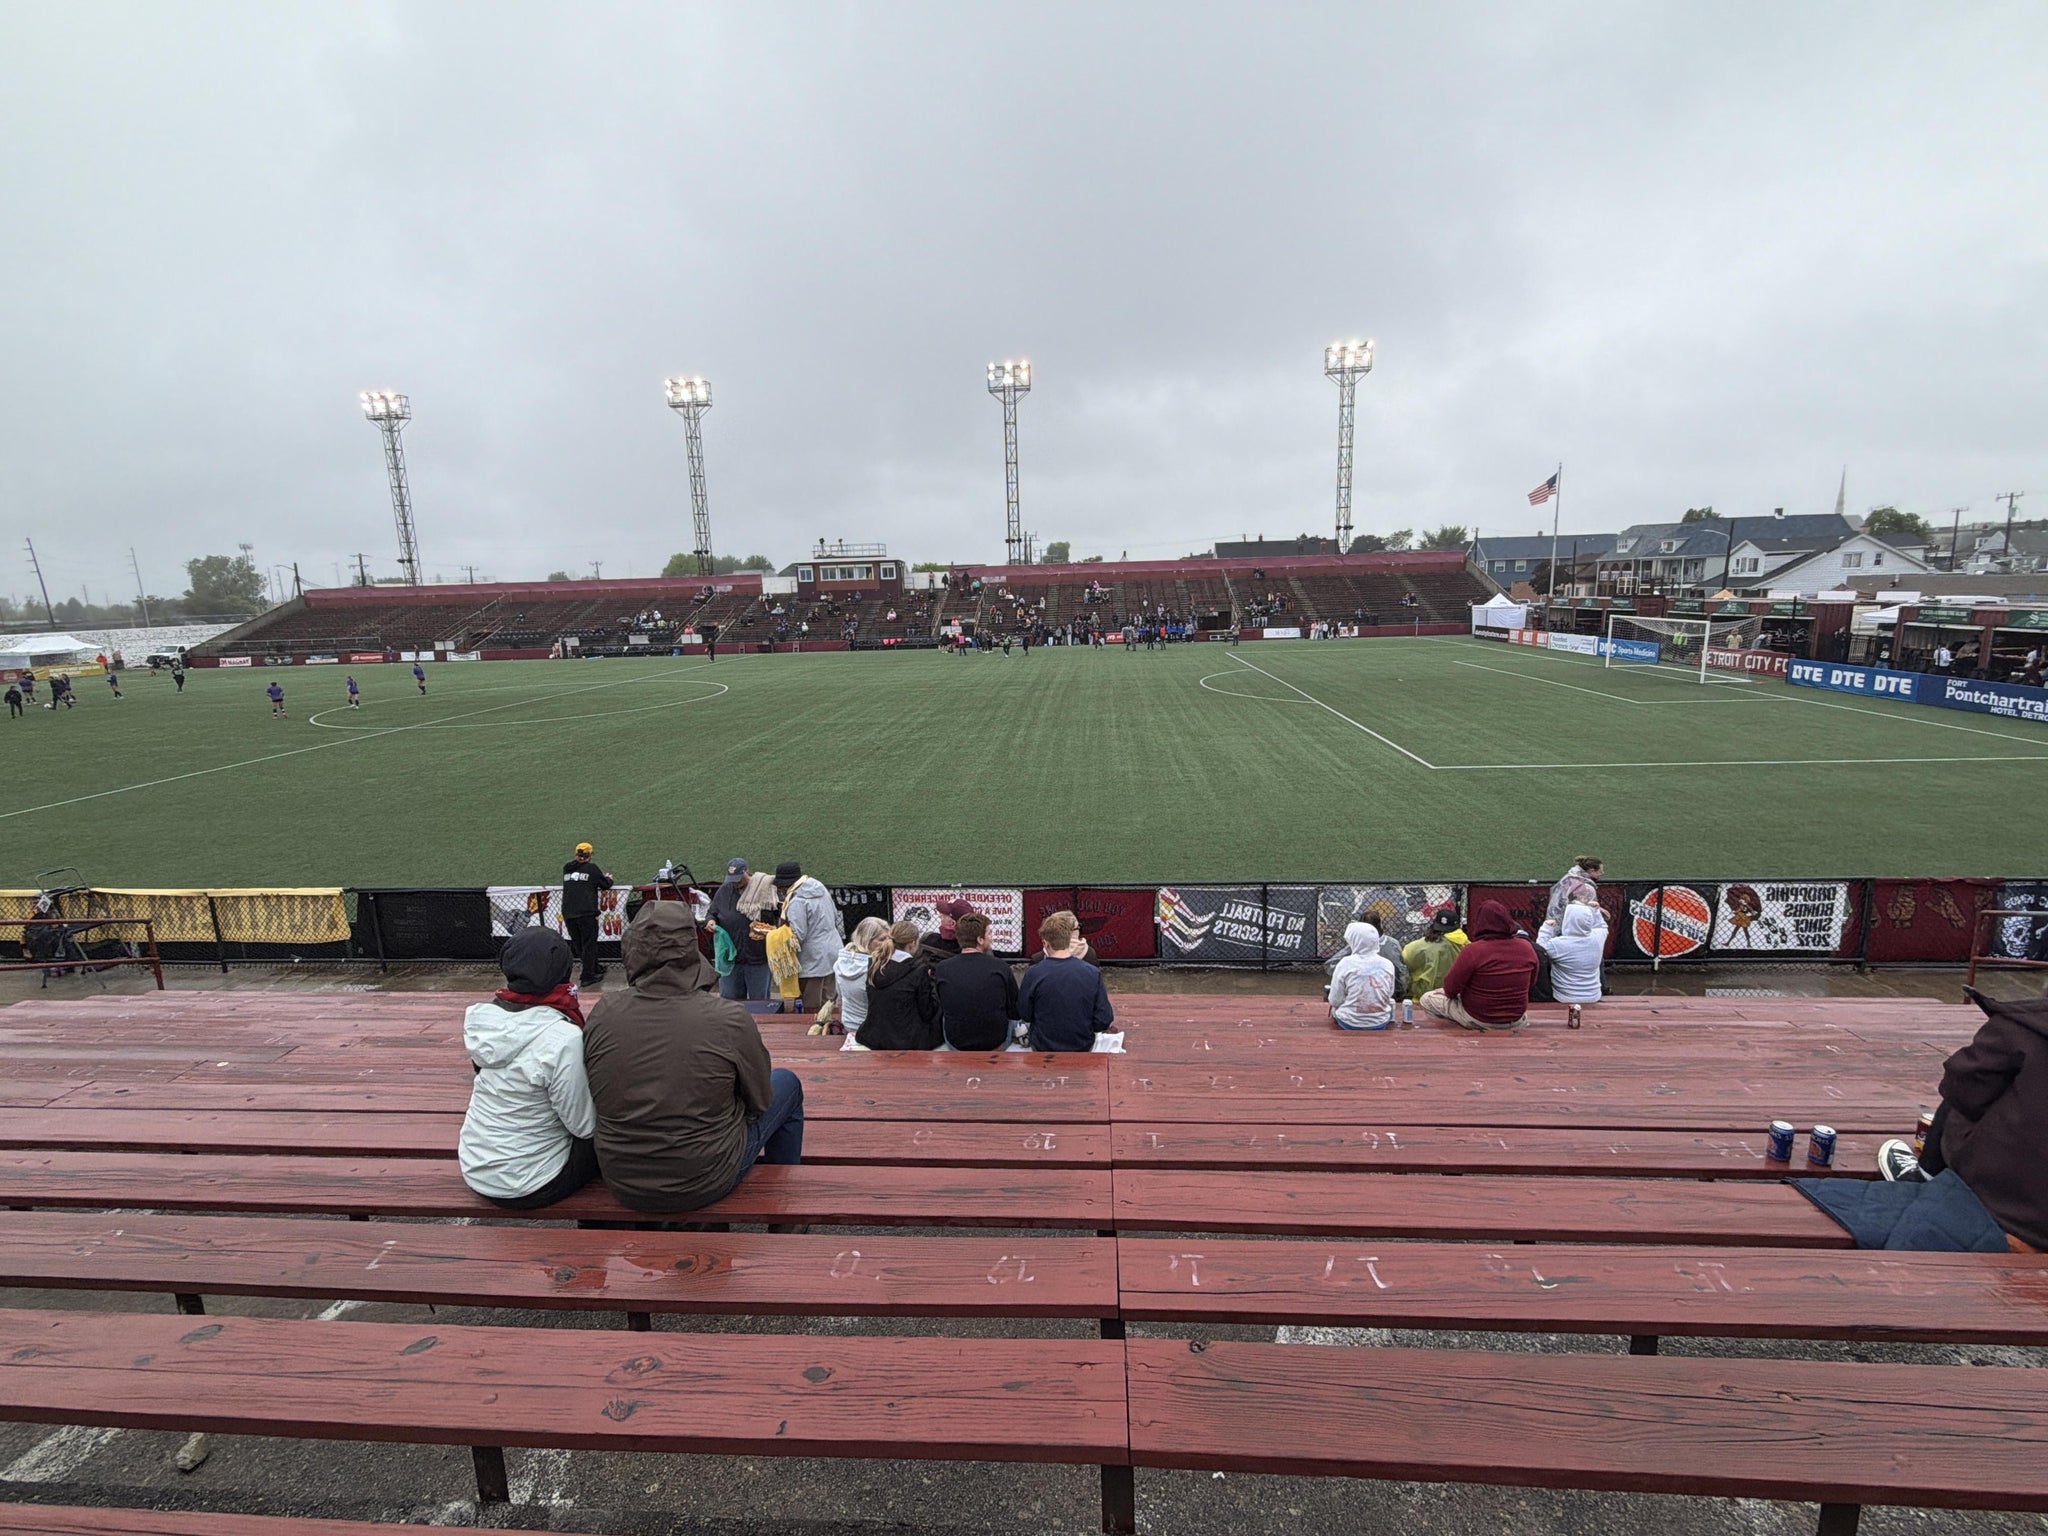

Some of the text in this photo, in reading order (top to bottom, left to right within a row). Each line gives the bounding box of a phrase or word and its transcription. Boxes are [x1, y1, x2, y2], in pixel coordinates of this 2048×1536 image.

[1599, 642, 1617, 654] DC
[1617, 645, 1633, 656] Sports
[1633, 647, 1657, 658] Medicine
[1701, 649, 1741, 668] ETROIT
[1744, 654, 1771, 671] CITY
[1791, 664, 1912, 695] DTE DTE DTE
[1946, 679, 1968, 688] FORT
[1990, 706, 2018, 717] HOTEL
